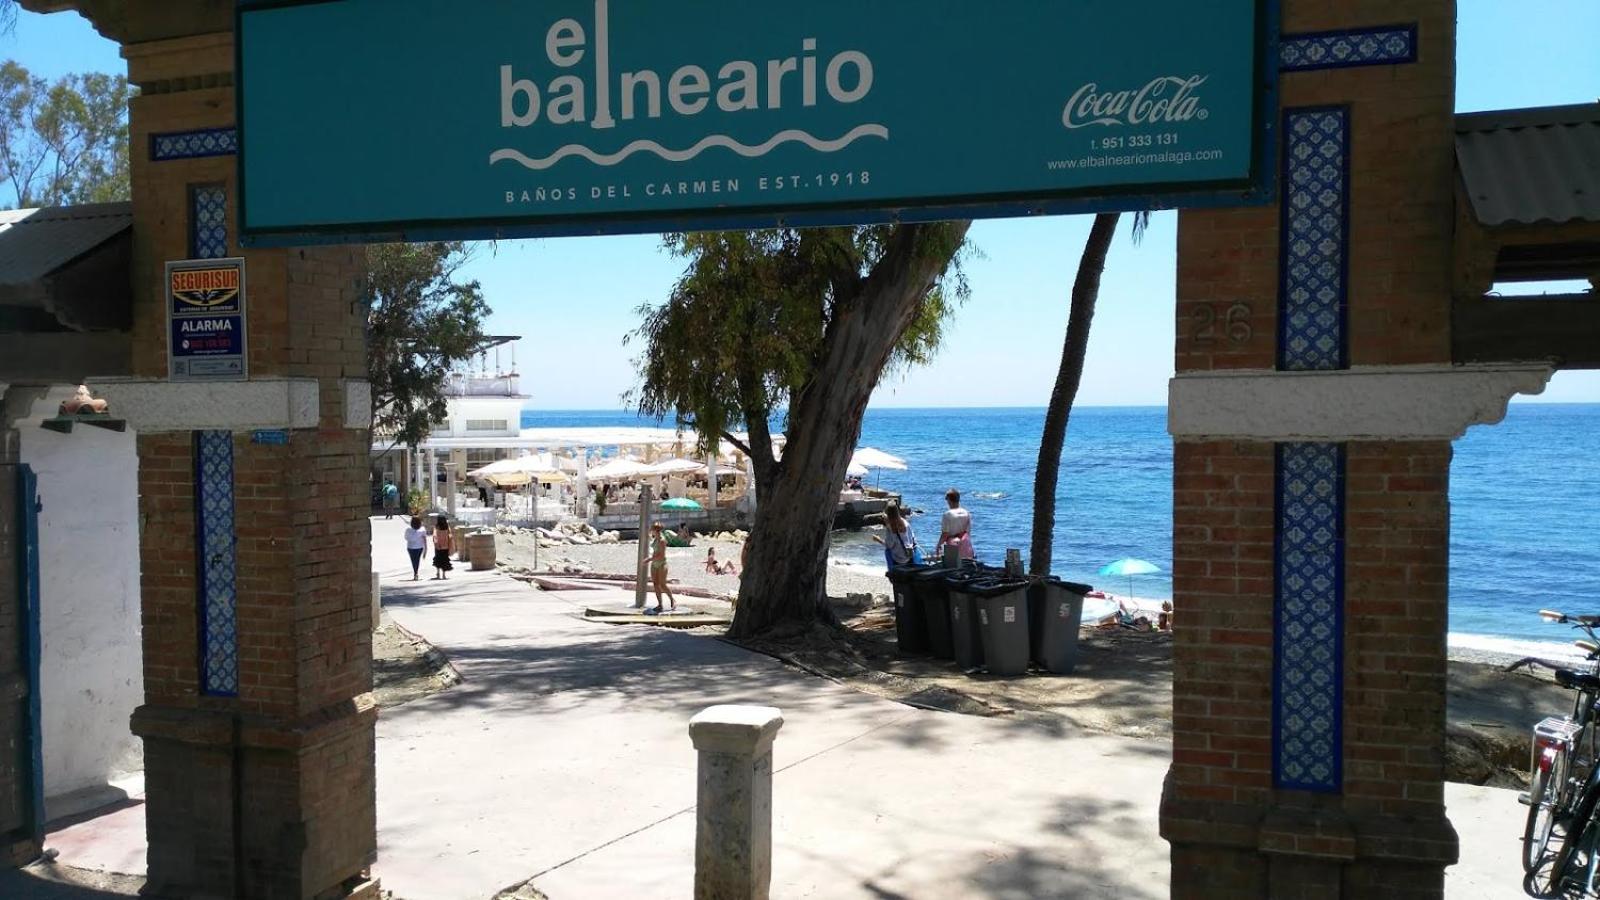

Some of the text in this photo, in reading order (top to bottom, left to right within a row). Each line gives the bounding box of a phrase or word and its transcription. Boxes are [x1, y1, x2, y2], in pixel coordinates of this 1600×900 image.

[500, 38, 874, 129] balneario
[1102, 137, 1124, 149] 951
[1128, 135, 1152, 147] 333
[1156, 133, 1178, 145] 131
[1047, 148, 1223, 170] www.elbalneariomalaga.com
[506, 186, 576, 203] BAÑOS
[591, 185, 630, 199] DEL
[645, 179, 738, 196] CARMEN
[172, 270, 238, 290] SEGURISUR
[180, 318, 233, 333] ALARMA
[1192, 301, 1253, 345] 26
